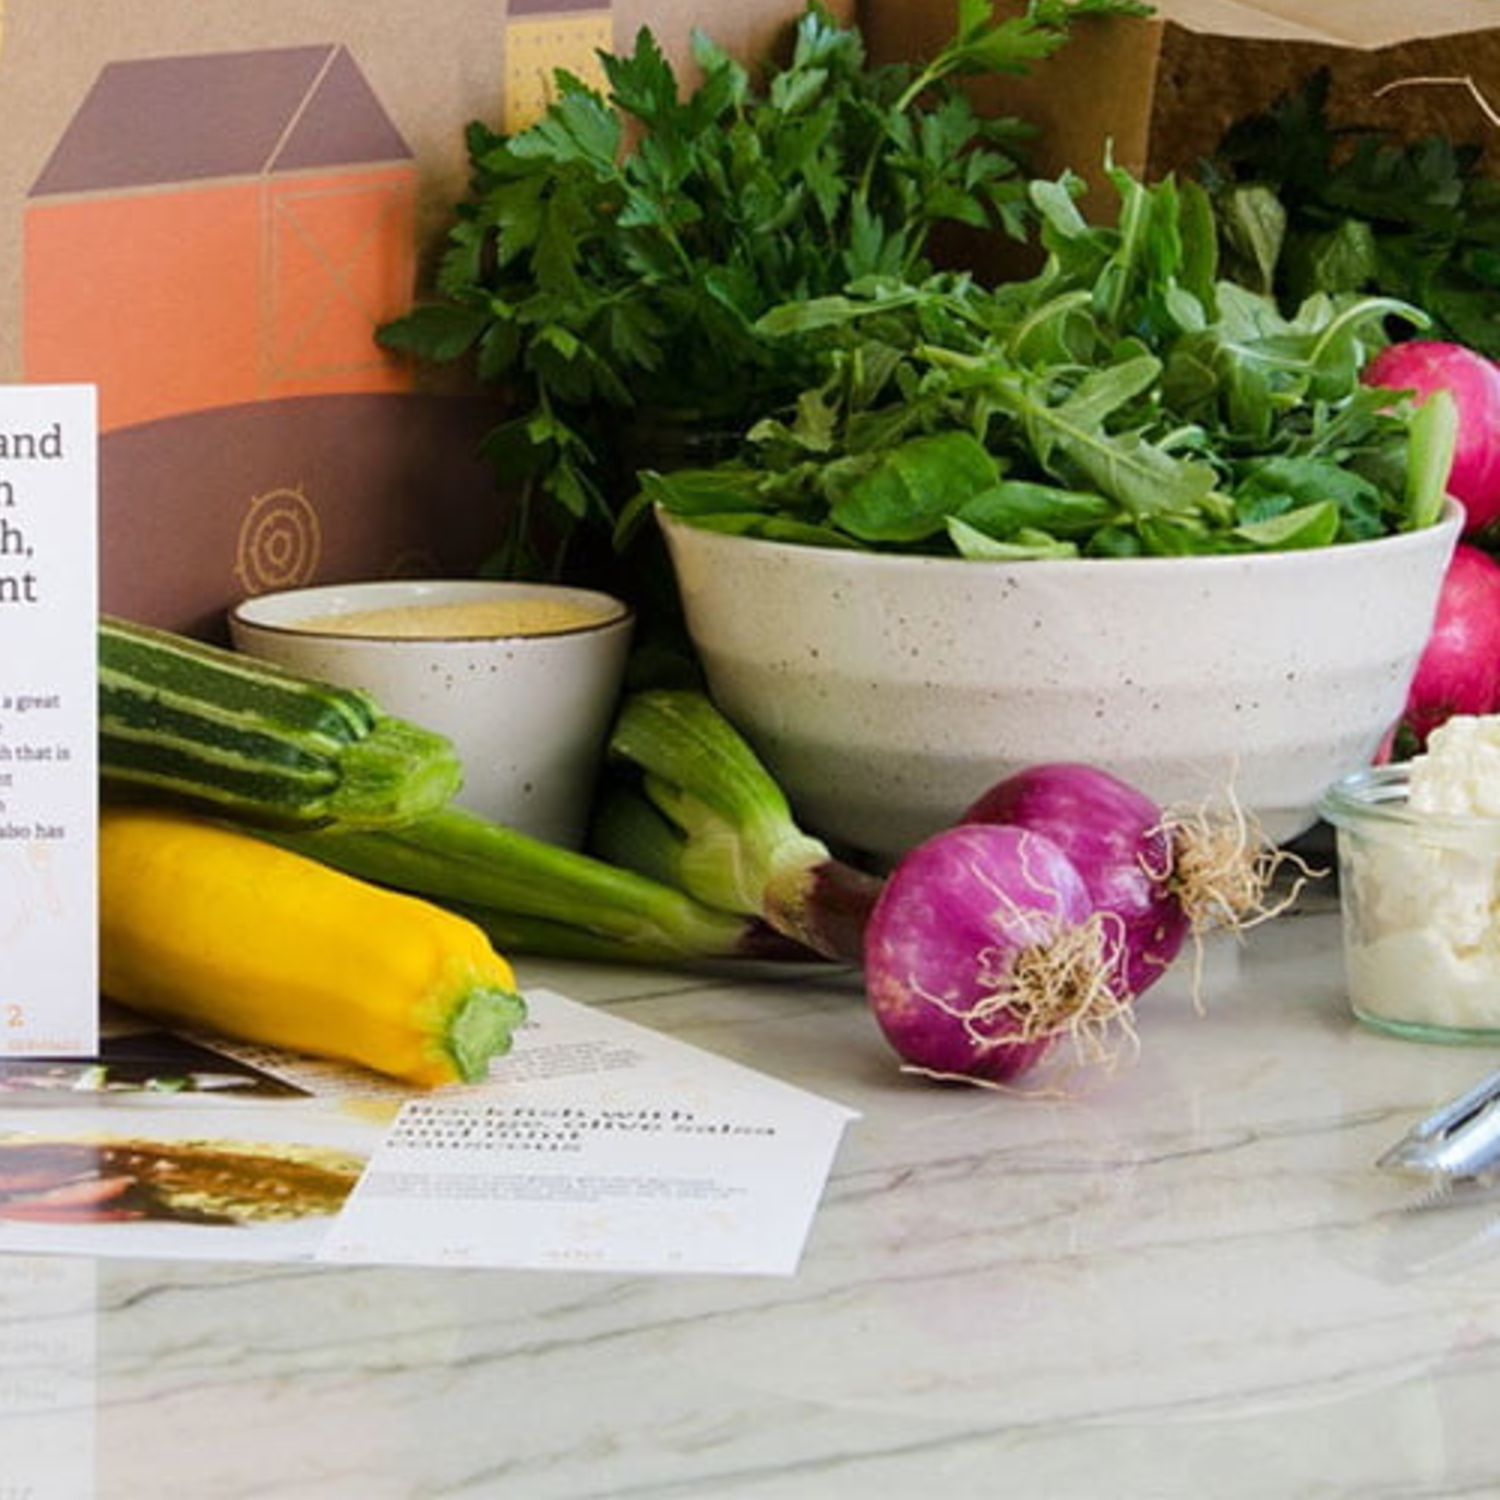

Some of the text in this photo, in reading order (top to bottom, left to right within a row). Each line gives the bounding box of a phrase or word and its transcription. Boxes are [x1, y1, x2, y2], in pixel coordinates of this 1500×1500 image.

[3, 697, 12, 709] a
[16, 695, 60, 711] great
[15, 745, 52, 760] that
[56, 746, 70, 760] is
[35, 822, 65, 838] has
[7, 1004, 26, 1027] 2
